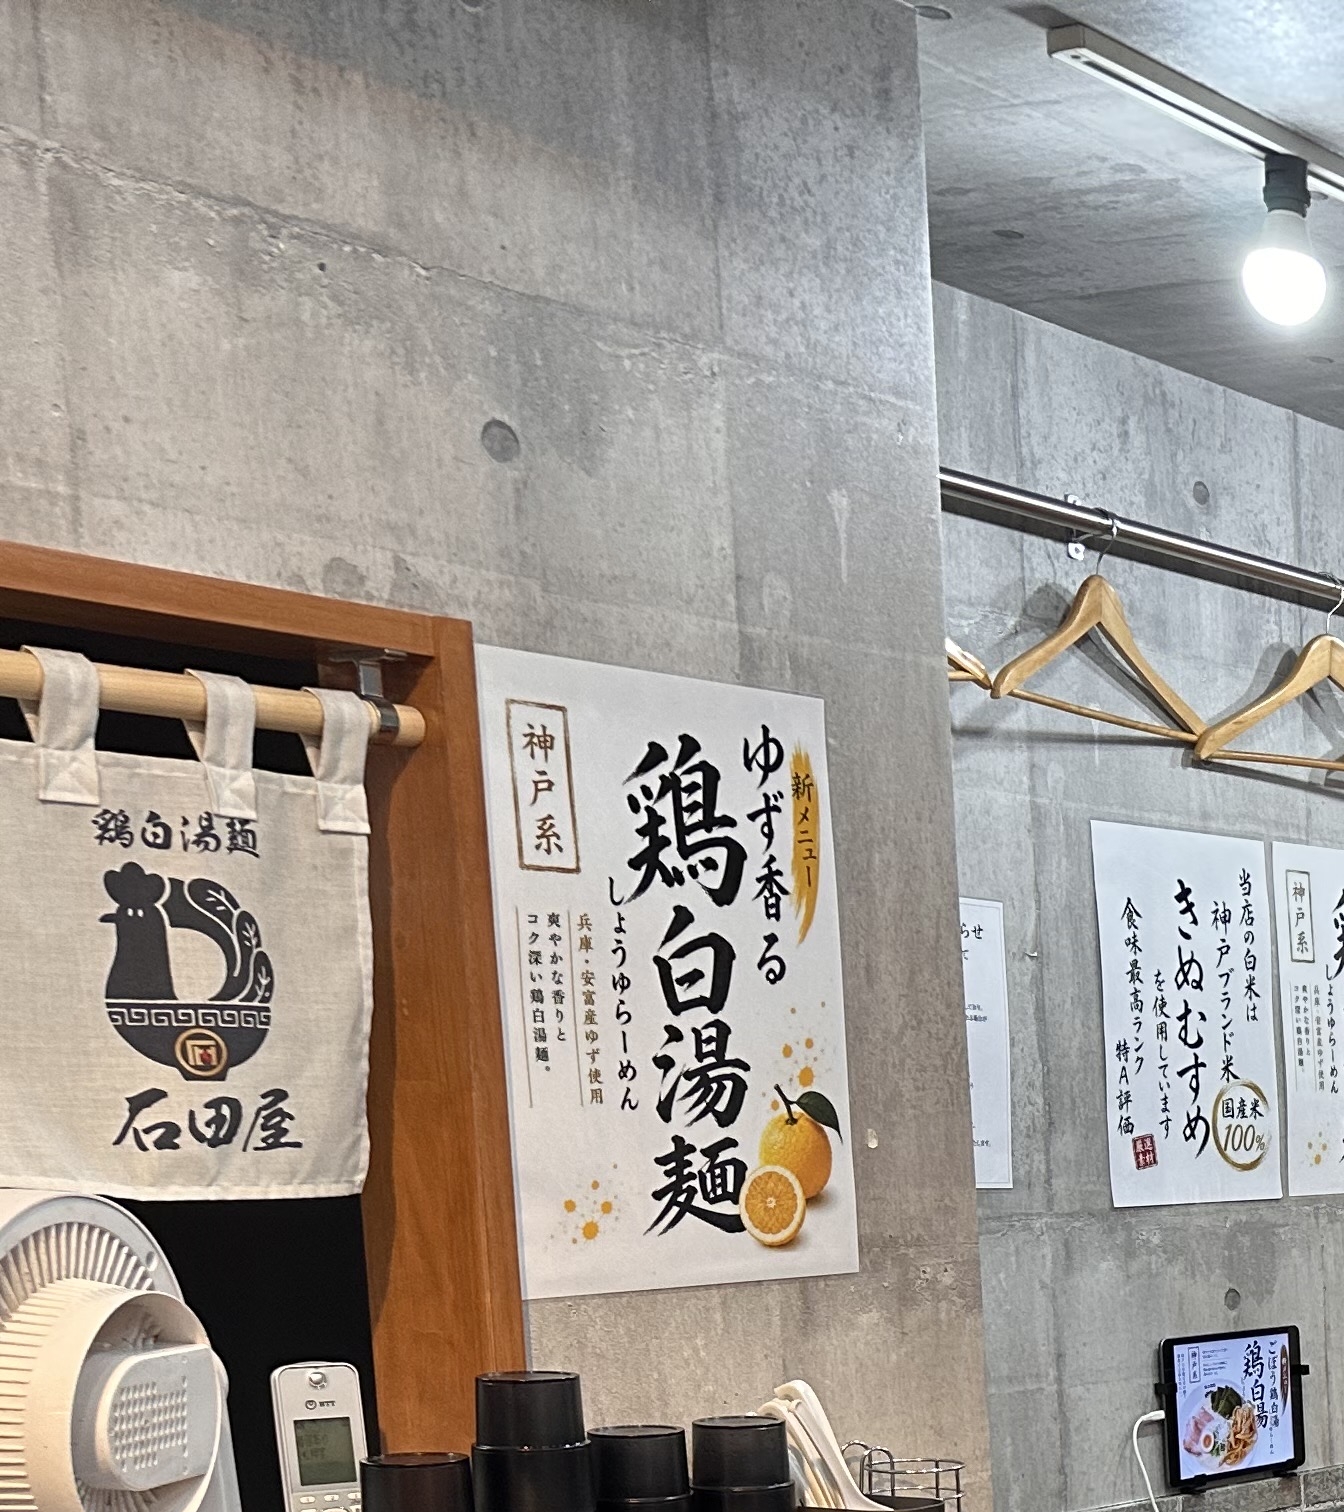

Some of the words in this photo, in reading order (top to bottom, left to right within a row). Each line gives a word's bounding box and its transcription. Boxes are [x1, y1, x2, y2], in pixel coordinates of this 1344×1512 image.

[91, 808, 260, 859] 鶏白湯麺
[523, 722, 564, 857] 神戸系
[743, 724, 791, 985] ゆず香る
[792, 773, 816, 888] 新メニュー
[546, 912, 567, 1043] 爽やかな香りと
[622, 733, 751, 1238] 鶏白湯麺
[1121, 897, 1144, 1075] 食味最高ランク
[1239, 867, 1260, 1022] 当店の白米は
[1292, 881, 1310, 954] 神戸系
[527, 913, 551, 1073] コク深い鶏白湯麺。
[576, 912, 604, 1105] 兵庫・安富産ゆず使用
[608, 877, 638, 1110] しょうゆらーめん
[1152, 969, 1173, 1139] を使用しています
[1173, 879, 1210, 1159] きぬむすめ
[1211, 901, 1240, 1081] 神戸ブランド米
[1325, 964, 1340, 1094] しょうゆらーめん
[112, 1087, 303, 1153] 石田屋
[1116, 1037, 1135, 1137] 特A評価
[1221, 1098, 1265, 1120] 国産米
[1223, 1122, 1266, 1152] 100%
